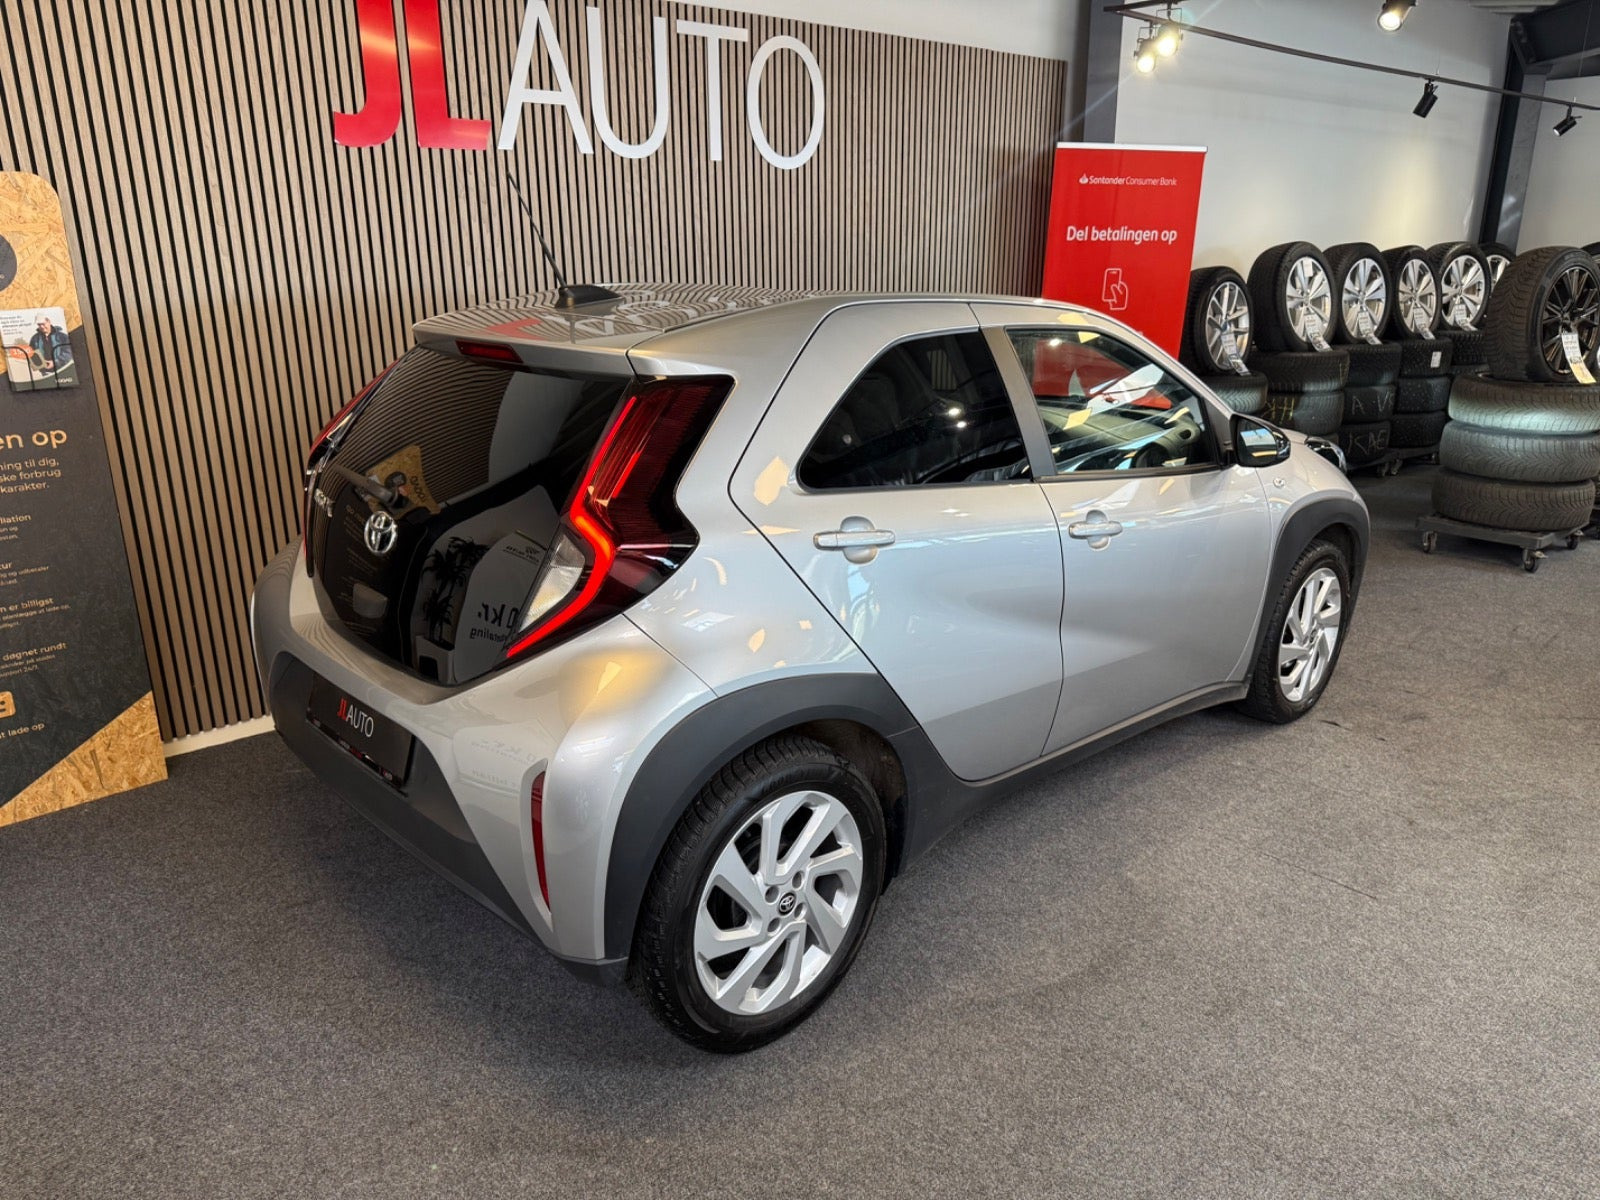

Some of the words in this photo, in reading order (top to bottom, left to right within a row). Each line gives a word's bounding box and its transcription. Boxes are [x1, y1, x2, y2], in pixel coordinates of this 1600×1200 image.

[1088, 175, 1125, 185] Santander
[1125, 176, 1160, 186] Consumer
[1160, 177, 1177, 186] Bank
[1066, 225, 1089, 242] Del
[1091, 226, 1159, 245] betalingen
[1161, 229, 1178, 245] op
[31, 429, 67, 449] op
[24, 458, 36, 468] til
[19, 469, 62, 480] forbrug
[21, 597, 54, 610] billigst
[40, 642, 67, 654] rundt
[8, 726, 30, 737] lade
[31, 722, 45, 732] op
